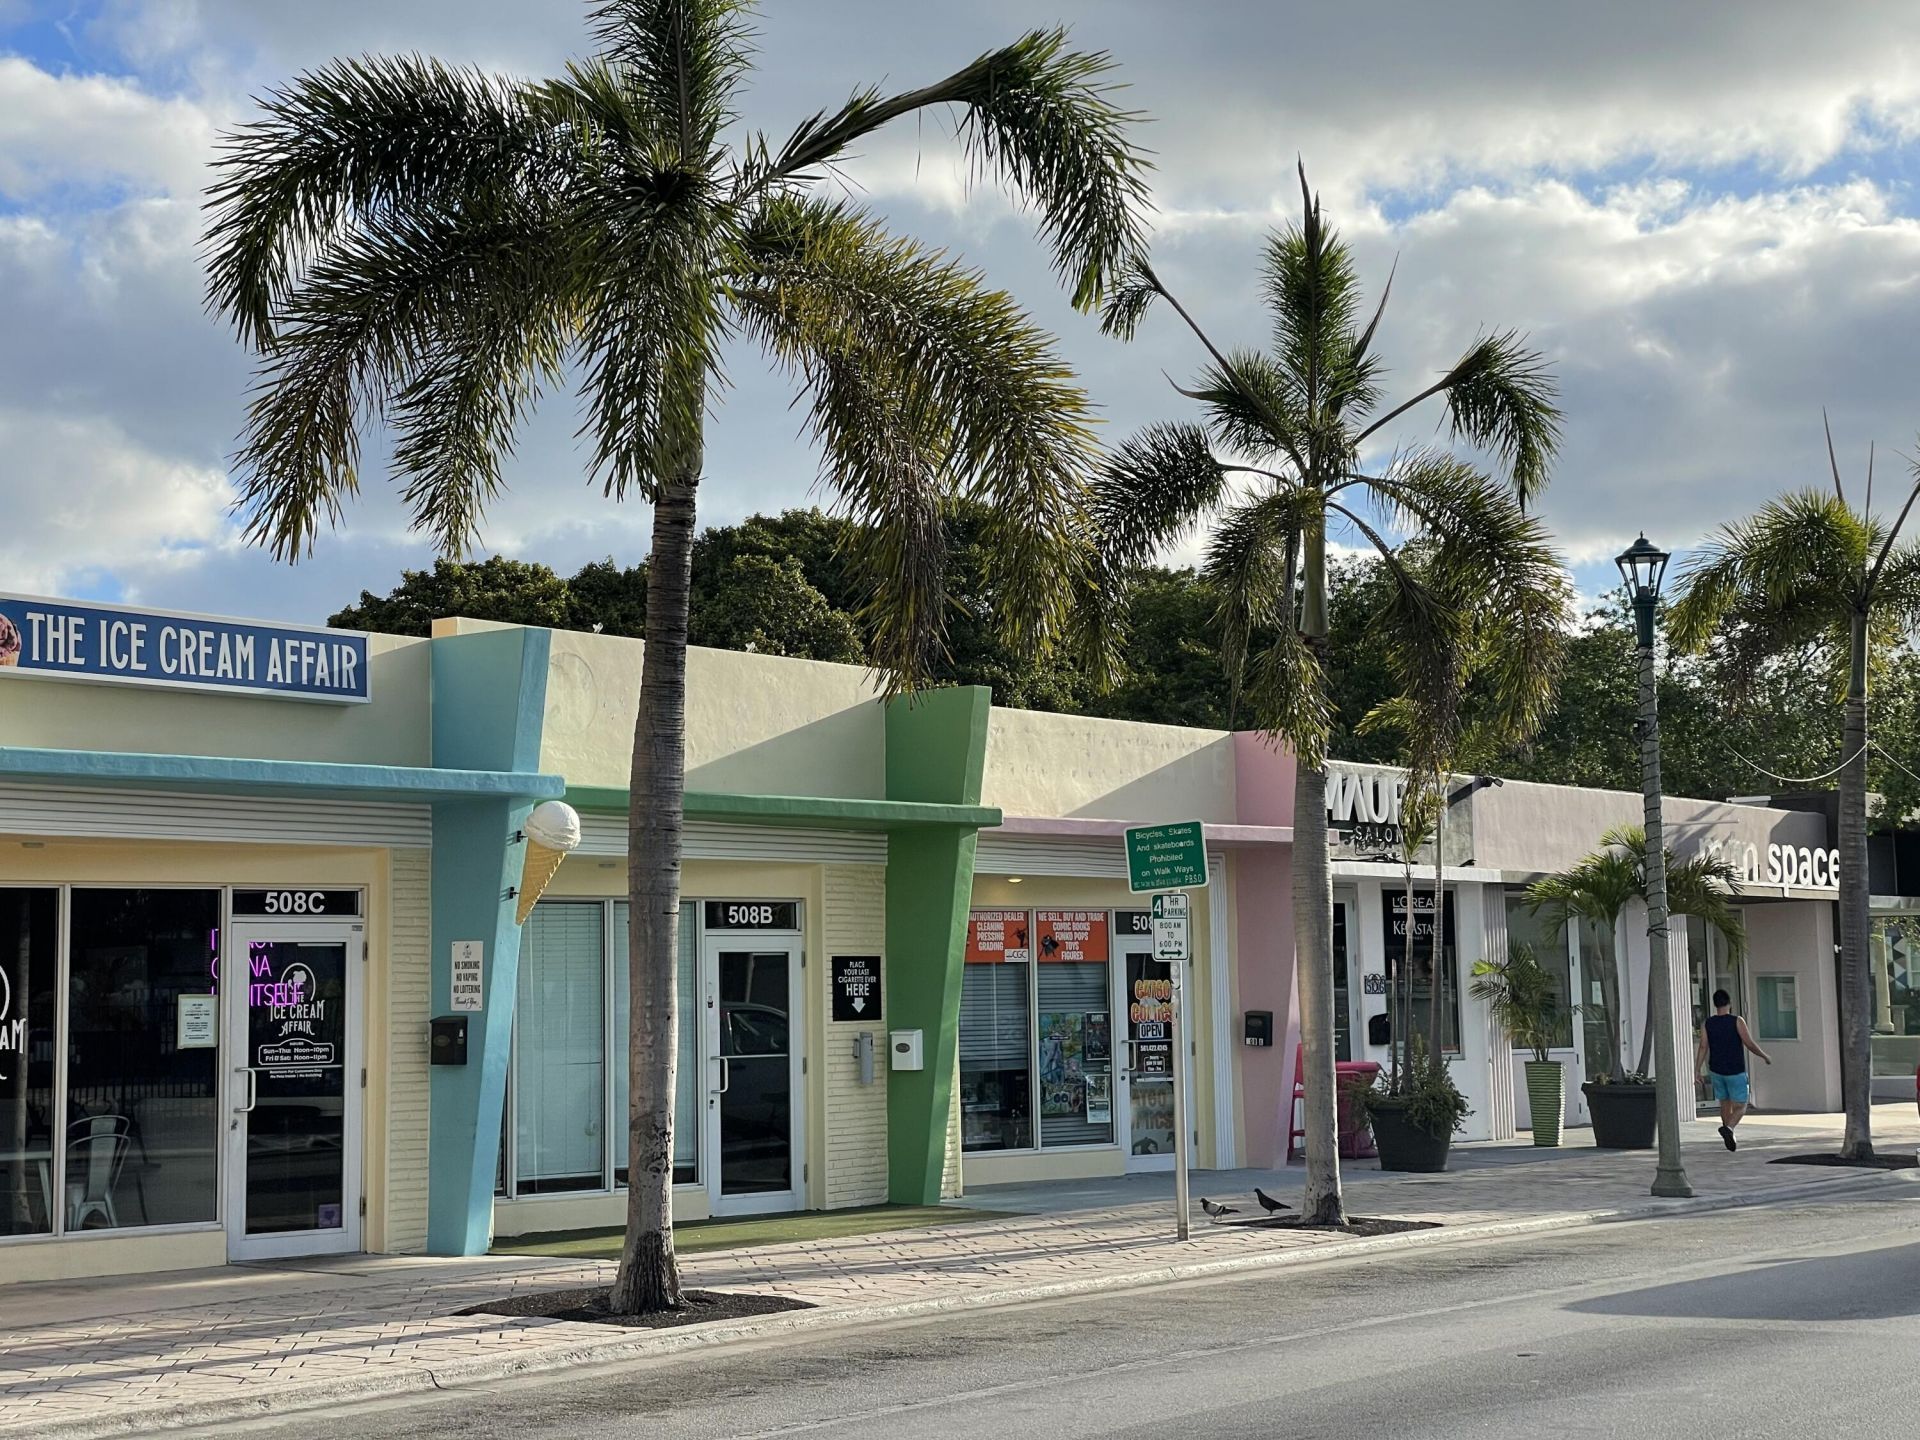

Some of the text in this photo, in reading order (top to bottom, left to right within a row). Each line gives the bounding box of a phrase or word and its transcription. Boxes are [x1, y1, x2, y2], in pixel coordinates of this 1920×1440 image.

[26, 612, 357, 690] THE ICE CREAM AFFAIR
[1168, 827, 1192, 836] Skates
[1136, 839, 1195, 852] And skateboards
[1149, 853, 1183, 863] Prohibited
[1141, 865, 1194, 877] on Walk Ways
[1766, 842, 1840, 898] space
[264, 890, 325, 914] 508C
[1169, 897, 1179, 906] HR
[1153, 898, 1162, 916] 4
[1163, 907, 1186, 916] PARKING
[728, 905, 773, 924] 508B
[1004, 911, 1025, 922] DEALER
[1038, 912, 1047, 922] WE
[1063, 912, 1074, 922] BUY
[1075, 912, 1087, 922] AND
[1087, 912, 1104, 922] TRADE
[976, 921, 1004, 931] CLEANING
[1053, 921, 1091, 931] COMIC BOOKS
[1159, 922, 1172, 930] 8:00
[976, 931, 1005, 941] PRESSING
[1055, 931, 1089, 941] FUNKO POPS
[978, 941, 1004, 951] GRADING
[1064, 941, 1080, 951] TOYS
[1012, 950, 1027, 959] CGC
[1061, 951, 1084, 961] FIGURES
[454, 961, 480, 970] NO SMOKING
[456, 973, 478, 981] NO VAPING
[843, 968, 869, 976] YOUR LAST
[838, 976, 864, 984] CIGARETTE
[453, 985, 481, 993] NO LOITERING
[846, 983, 870, 996] HERE
[270, 1000, 325, 1022] ICE CREAM
[278, 1020, 316, 1036] AFFAIR
[1140, 1024, 1162, 1038] OPEN
